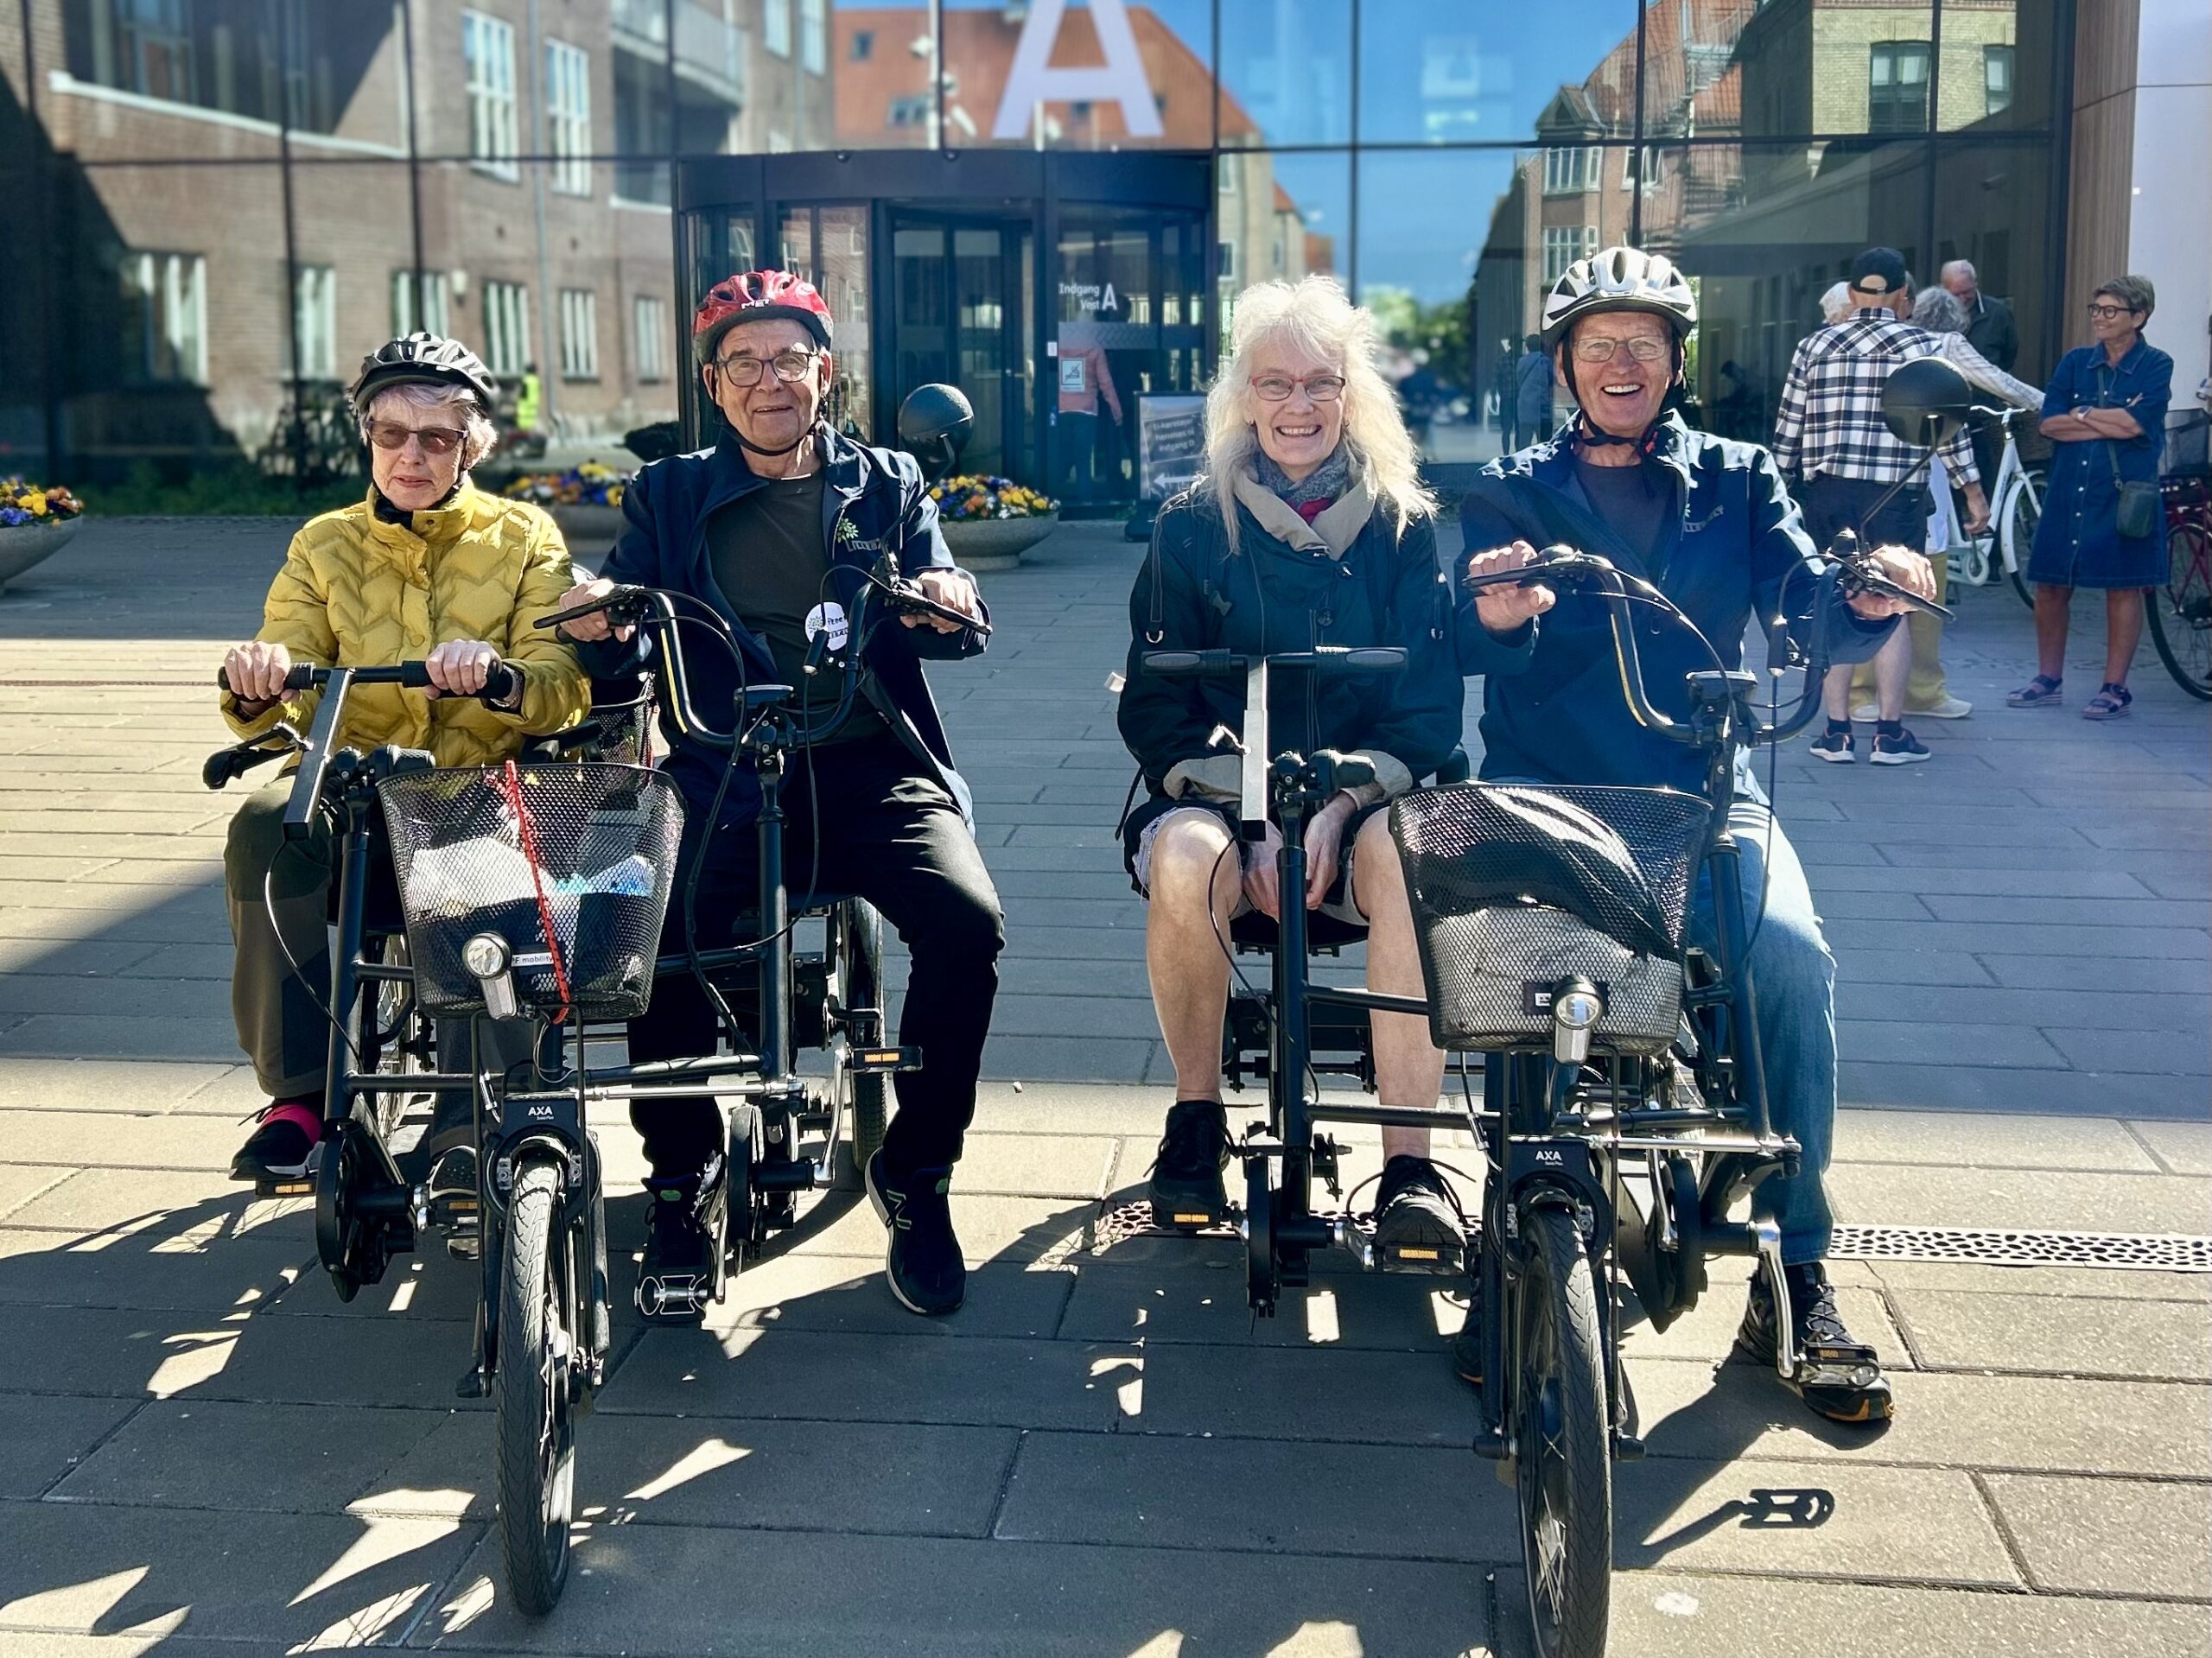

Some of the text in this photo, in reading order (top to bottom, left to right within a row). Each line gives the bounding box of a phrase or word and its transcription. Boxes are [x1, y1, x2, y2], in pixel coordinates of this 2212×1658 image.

[991, 0, 1164, 139] A
[1058, 283, 1099, 297] Indgang
[1102, 283, 1118, 310] A
[1080, 299, 1099, 310] Vest
[522, 955, 553, 963] mobility
[528, 1106, 553, 1115] AXA
[1535, 1150, 1562, 1160] AXA
